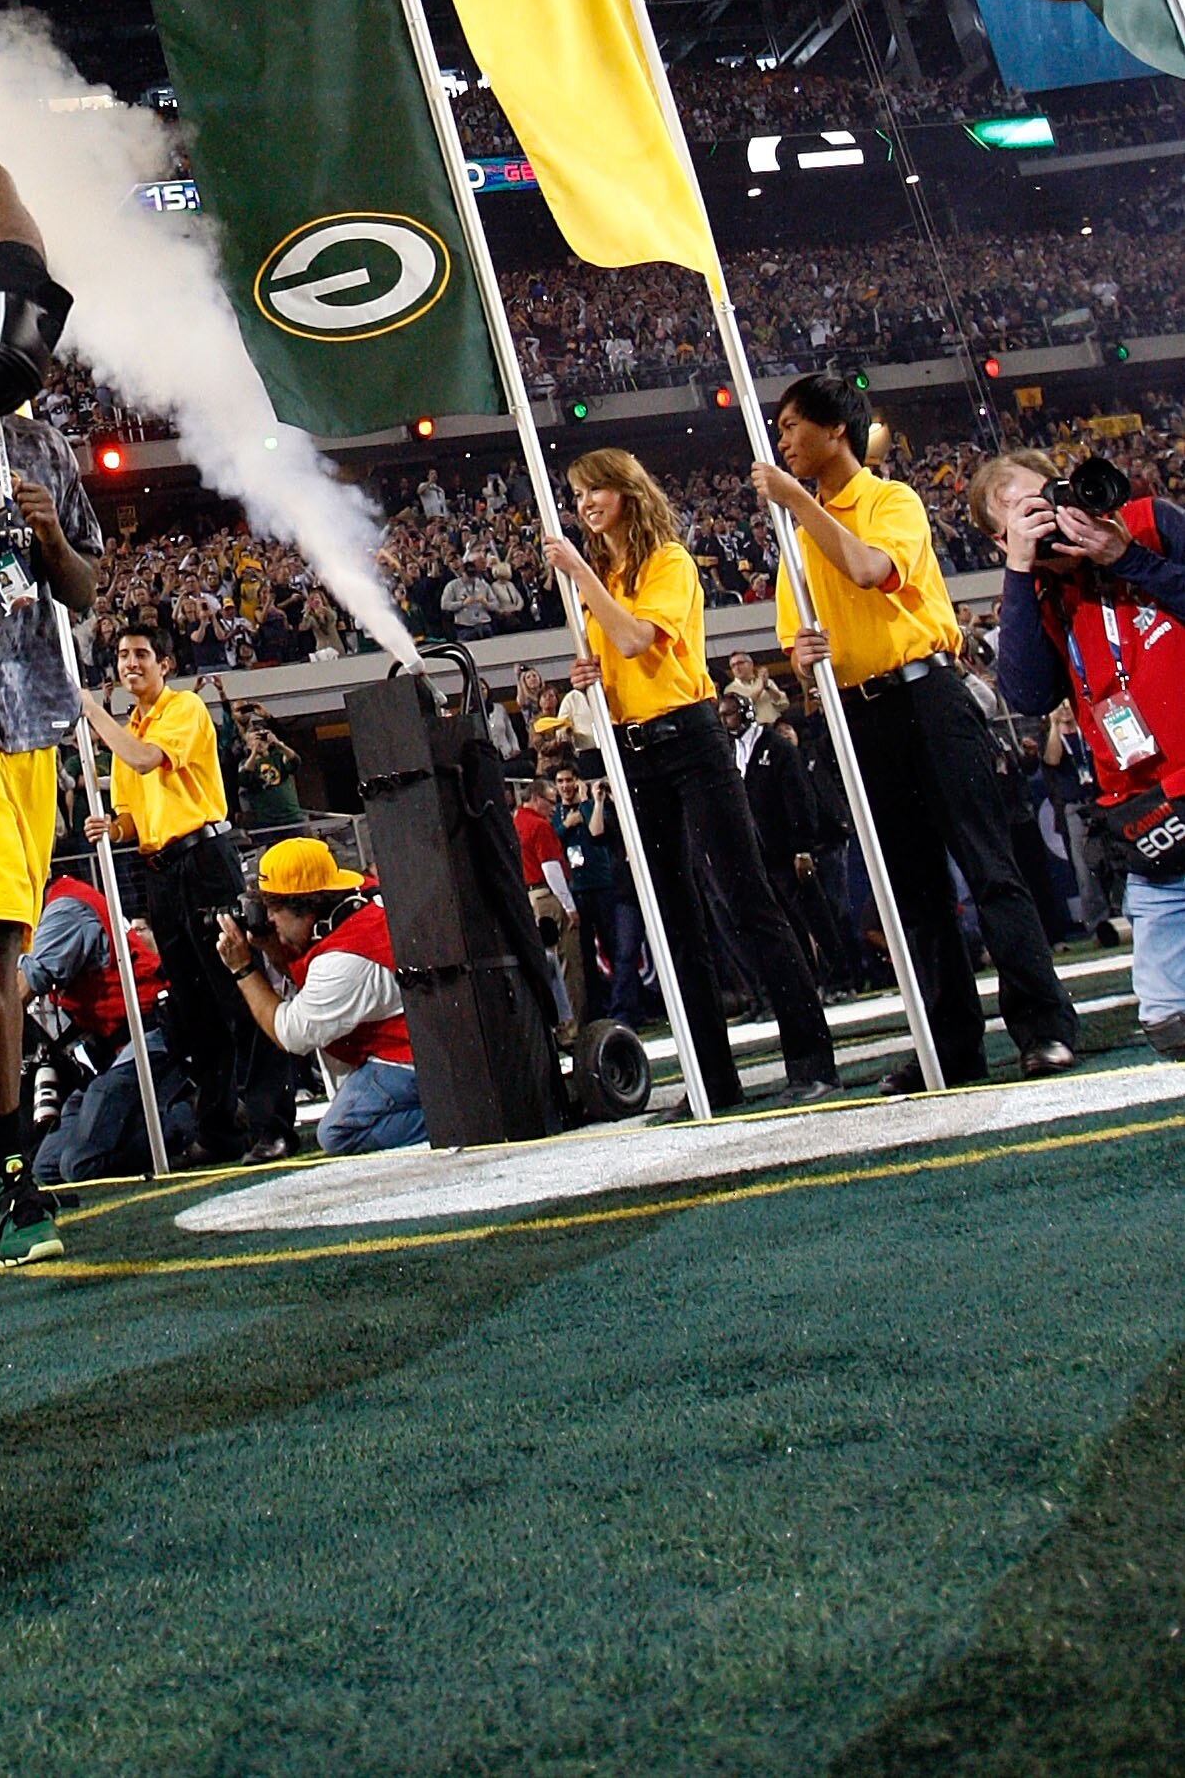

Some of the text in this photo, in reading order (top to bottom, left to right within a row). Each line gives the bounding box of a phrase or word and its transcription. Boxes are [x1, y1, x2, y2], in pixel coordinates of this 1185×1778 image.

[145, 184, 201, 212] 15:
[1143, 621, 1173, 651] Canon
[1122, 801, 1173, 842] Canon
[1136, 815, 1185, 859] EOS
